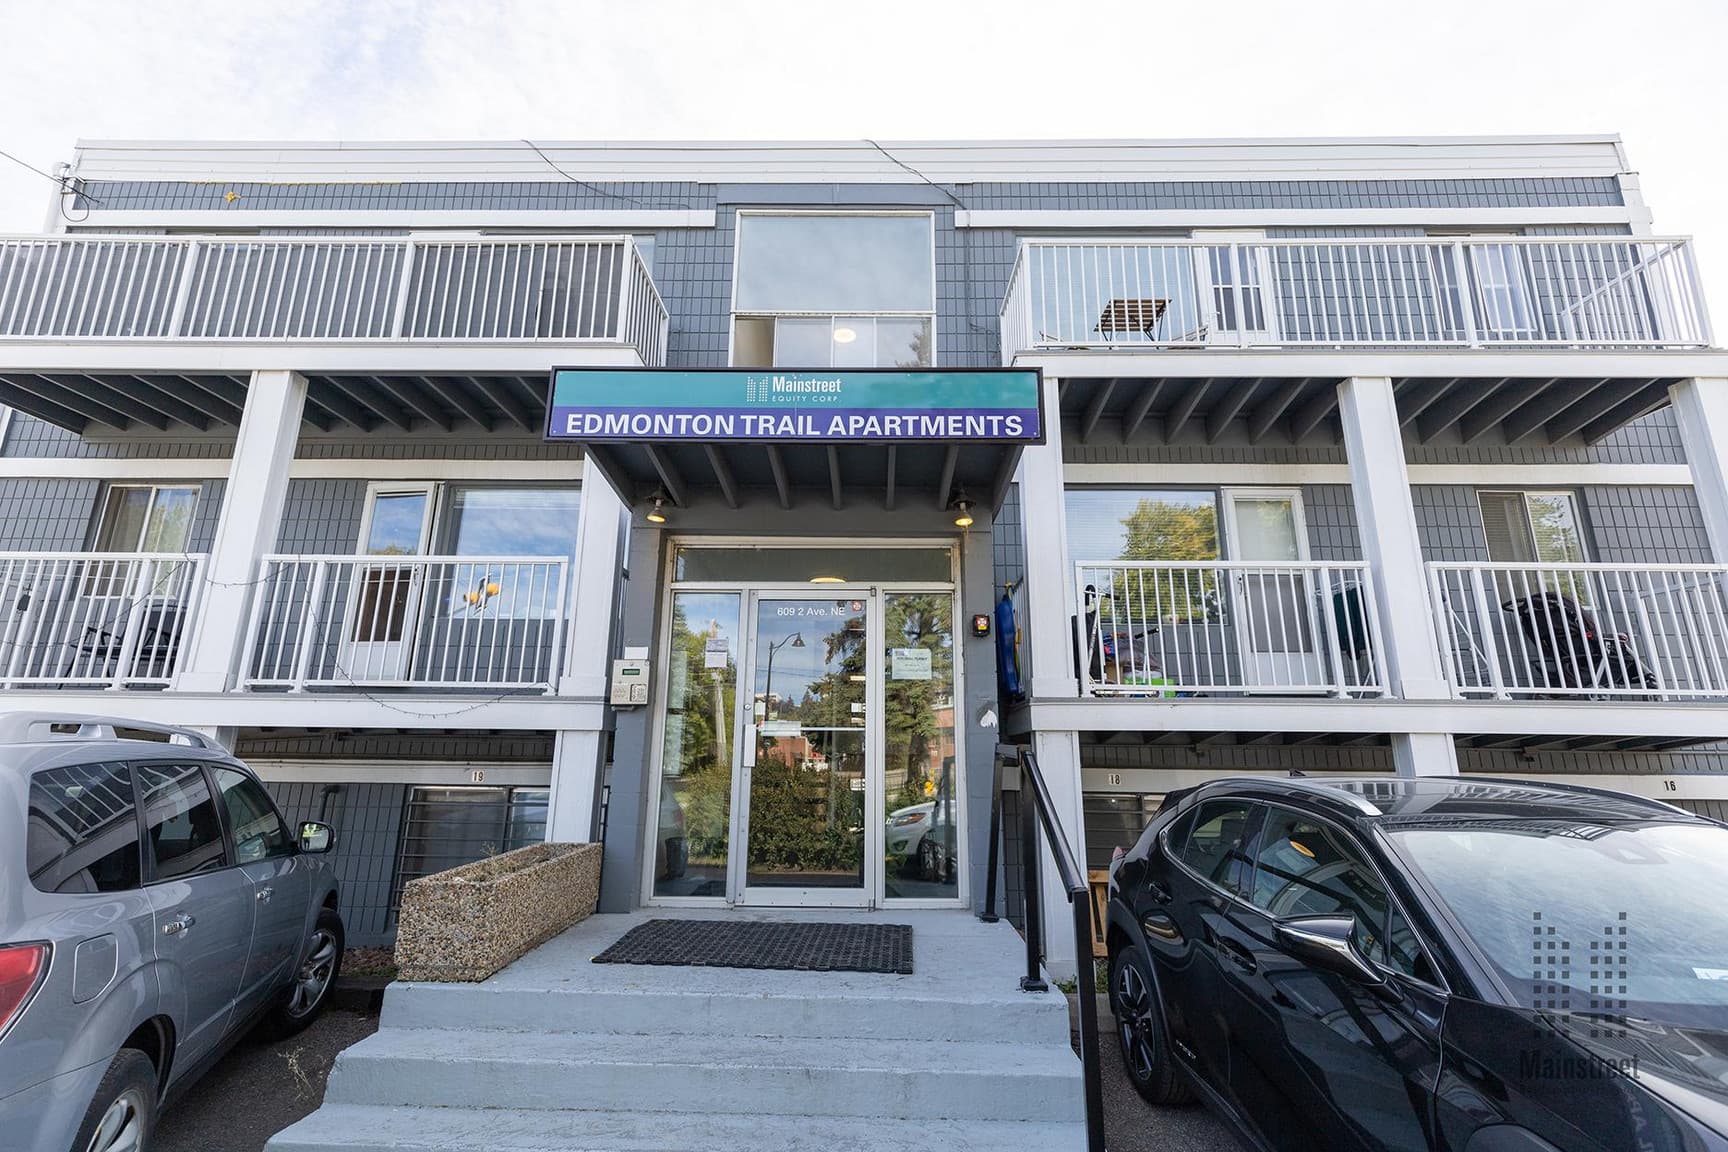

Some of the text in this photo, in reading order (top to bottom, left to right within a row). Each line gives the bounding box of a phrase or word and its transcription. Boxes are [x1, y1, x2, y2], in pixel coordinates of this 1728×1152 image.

[772, 376, 842, 393] Mainstreet
[566, 414, 1024, 436] EDMONTON TRAIL APARTMENTS
[777, 607, 846, 616] 609 2 Ave. NE
[474, 771, 484, 782] 19
[1111, 774, 1121, 785] 18
[1664, 780, 1676, 791] 16
